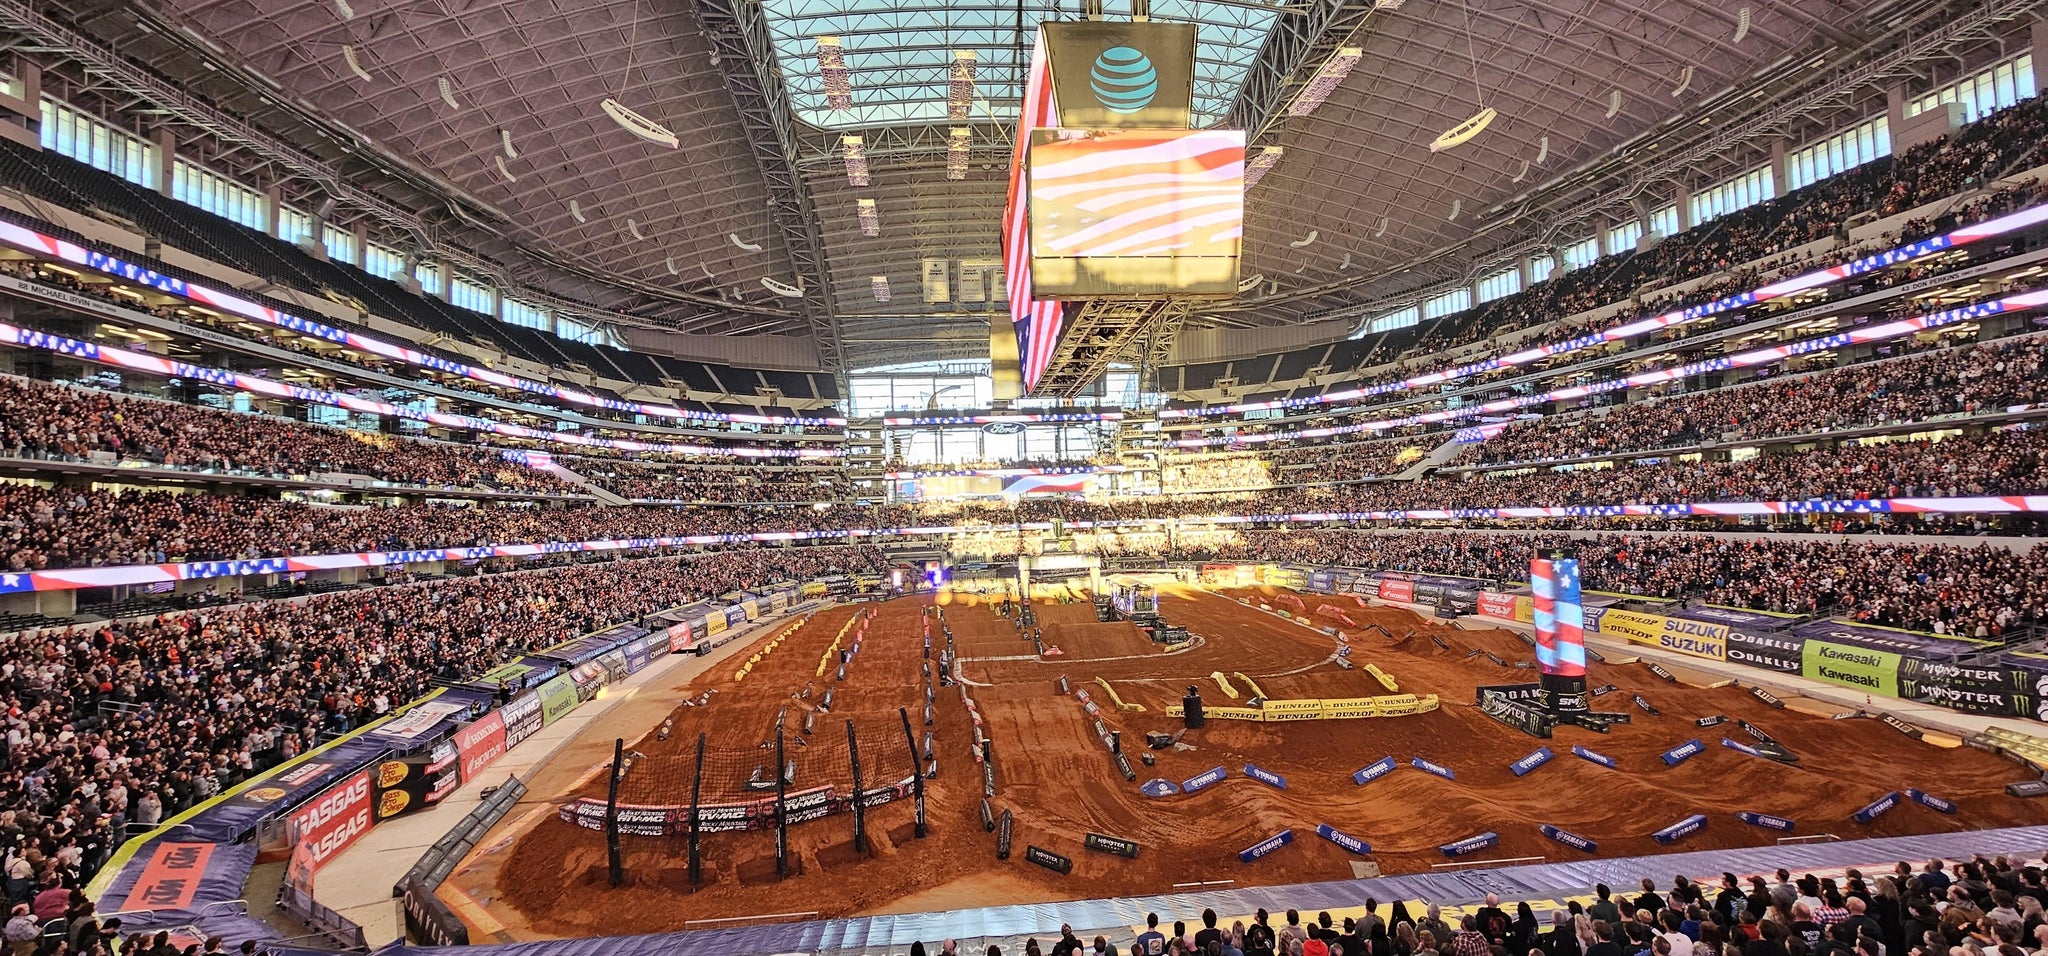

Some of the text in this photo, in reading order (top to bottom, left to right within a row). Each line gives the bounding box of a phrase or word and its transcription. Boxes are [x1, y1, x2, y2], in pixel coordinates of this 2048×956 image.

[1912, 281, 1927, 290] DON
[1929, 274, 1960, 287] PERKINS
[18, 281, 28, 290] 88
[31, 285, 69, 301] MICHAEL
[69, 295, 91, 307] IRVIN
[1797, 309, 1814, 319] LILLY
[185, 326, 201, 336] TROY
[202, 330, 224, 342] AIKMAN
[1681, 335, 1704, 346] MEREDITH
[990, 423, 1020, 434] Ford
[1390, 582, 1409, 590] HONDA
[1388, 592, 1409, 600] HONDA
[1482, 603, 1513, 615] FLY
[1615, 613, 1658, 625] DUNLOP
[1664, 619, 1725, 640] SUZUKI
[1611, 625, 1723, 657] DUNLOP SUZUKI
[1746, 635, 1801, 651] OAKLEY
[1853, 635, 1920, 650] OAKLEY
[1744, 653, 1800, 670] OAKLEY
[1818, 646, 1881, 667] Kawasaki
[1818, 666, 1880, 689] Kawasaki
[1922, 663, 2003, 681] MONSTER
[1558, 695, 1587, 708] SMX
[1921, 685, 2004, 706] MONSTER
[549, 695, 573, 718] Kawasaki
[1386, 707, 1417, 715] DUNLOP
[470, 721, 499, 743] HONDA
[474, 743, 501, 769] HONDA
[383, 762, 400, 771] Bass
[383, 773, 404, 784] Shops
[384, 790, 401, 800] Bass
[294, 777, 368, 836] GASGAS
[384, 802, 406, 813] Shops
[801, 805, 829, 815] MOUNTAIN
[1928, 797, 1949, 809] YAMAHA
[1764, 817, 1786, 828] YAMAHA
[311, 807, 368, 863] ASGAS
[1337, 833, 1362, 849] YAMAHA
[1562, 834, 1587, 848] YAMAHA
[1097, 837, 1125, 849] MONSTER
[1258, 837, 1283, 852] YAMAHA
[1463, 840, 1488, 851] YAMAHA
[161, 847, 203, 869] KTM
[1035, 850, 1058, 863] MONSTER
[140, 879, 188, 905] KTM
